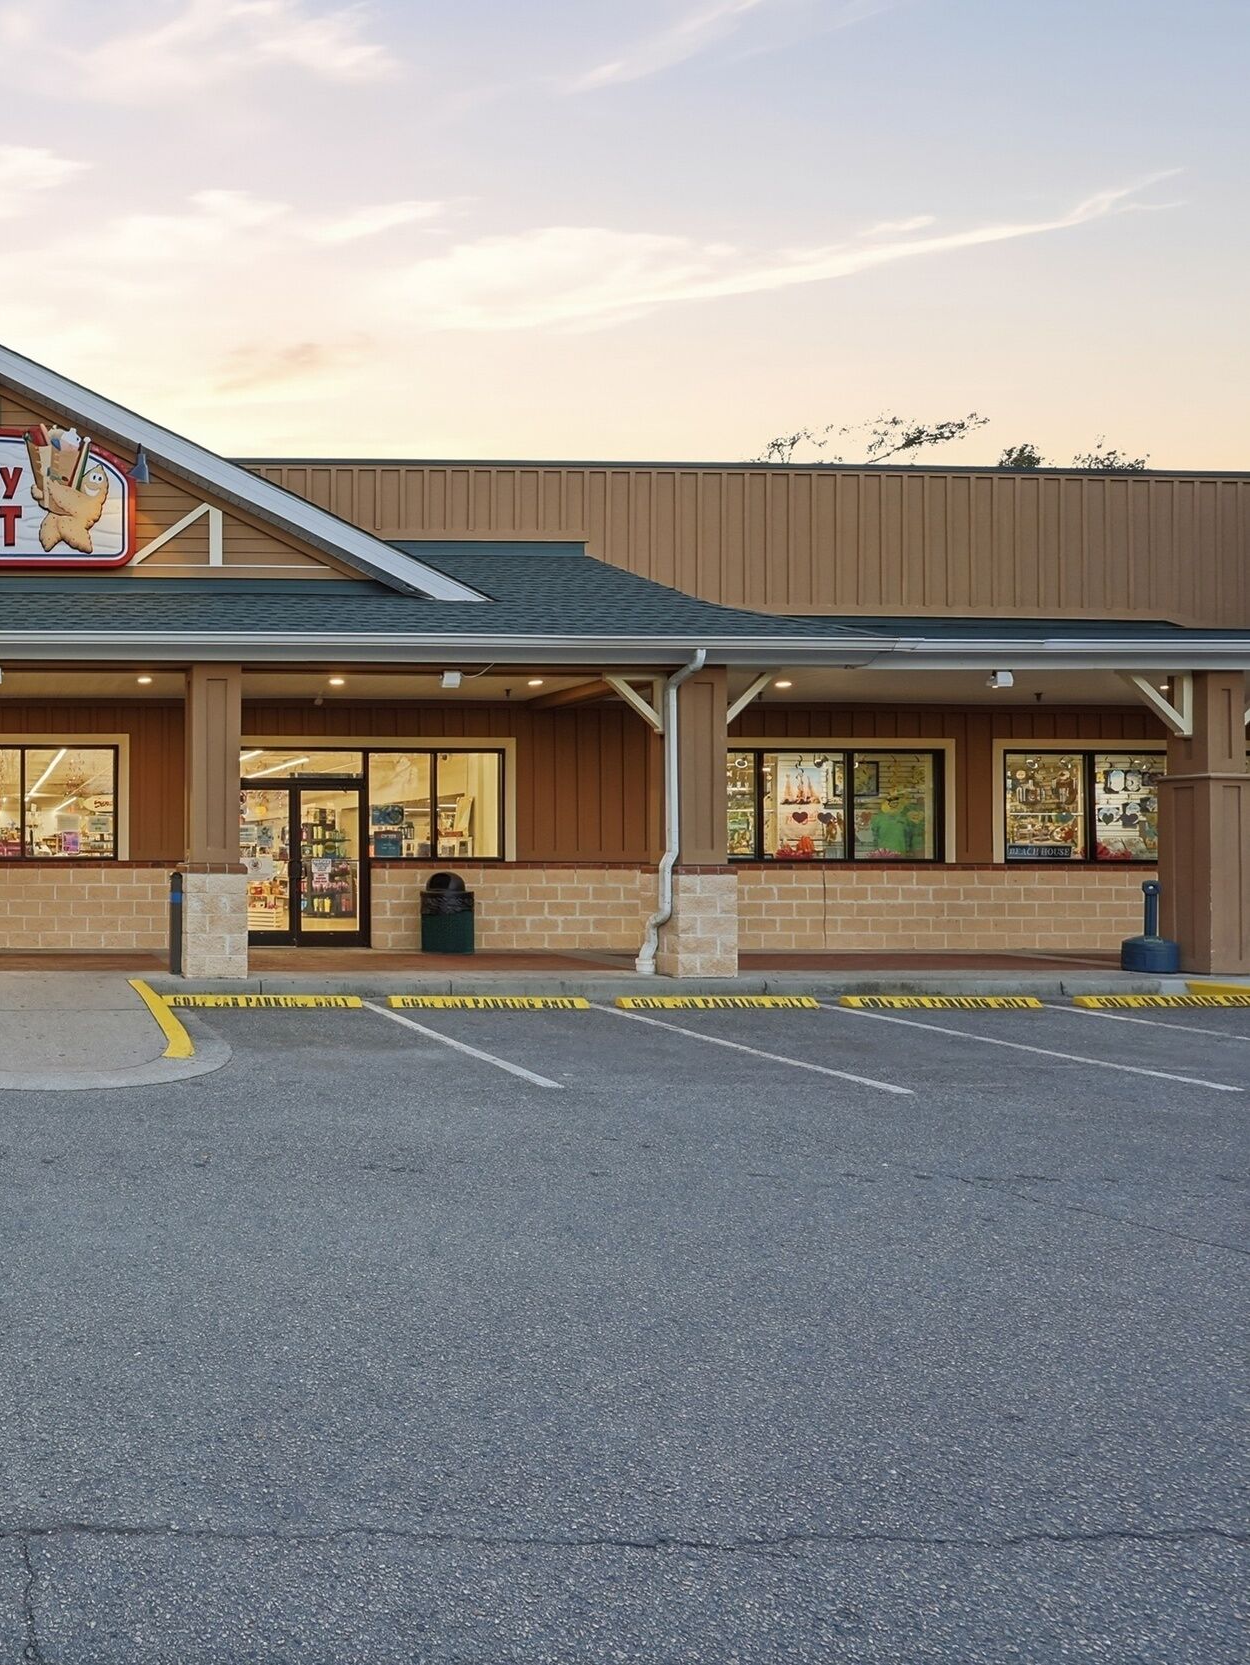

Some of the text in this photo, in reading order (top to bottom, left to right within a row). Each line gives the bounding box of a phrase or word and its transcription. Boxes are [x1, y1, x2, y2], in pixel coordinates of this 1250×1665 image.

[1009, 847, 1070, 856] BEACH HOUSE
[313, 997, 350, 1007] ONLY
[473, 998, 536, 1008] PARKING
[540, 998, 576, 1008] ONLY
[702, 998, 765, 1008] PARKING
[928, 998, 993, 1008] PARKING
[994, 998, 1033, 1008] ONLY
[1160, 996, 1223, 1007] PARKING
